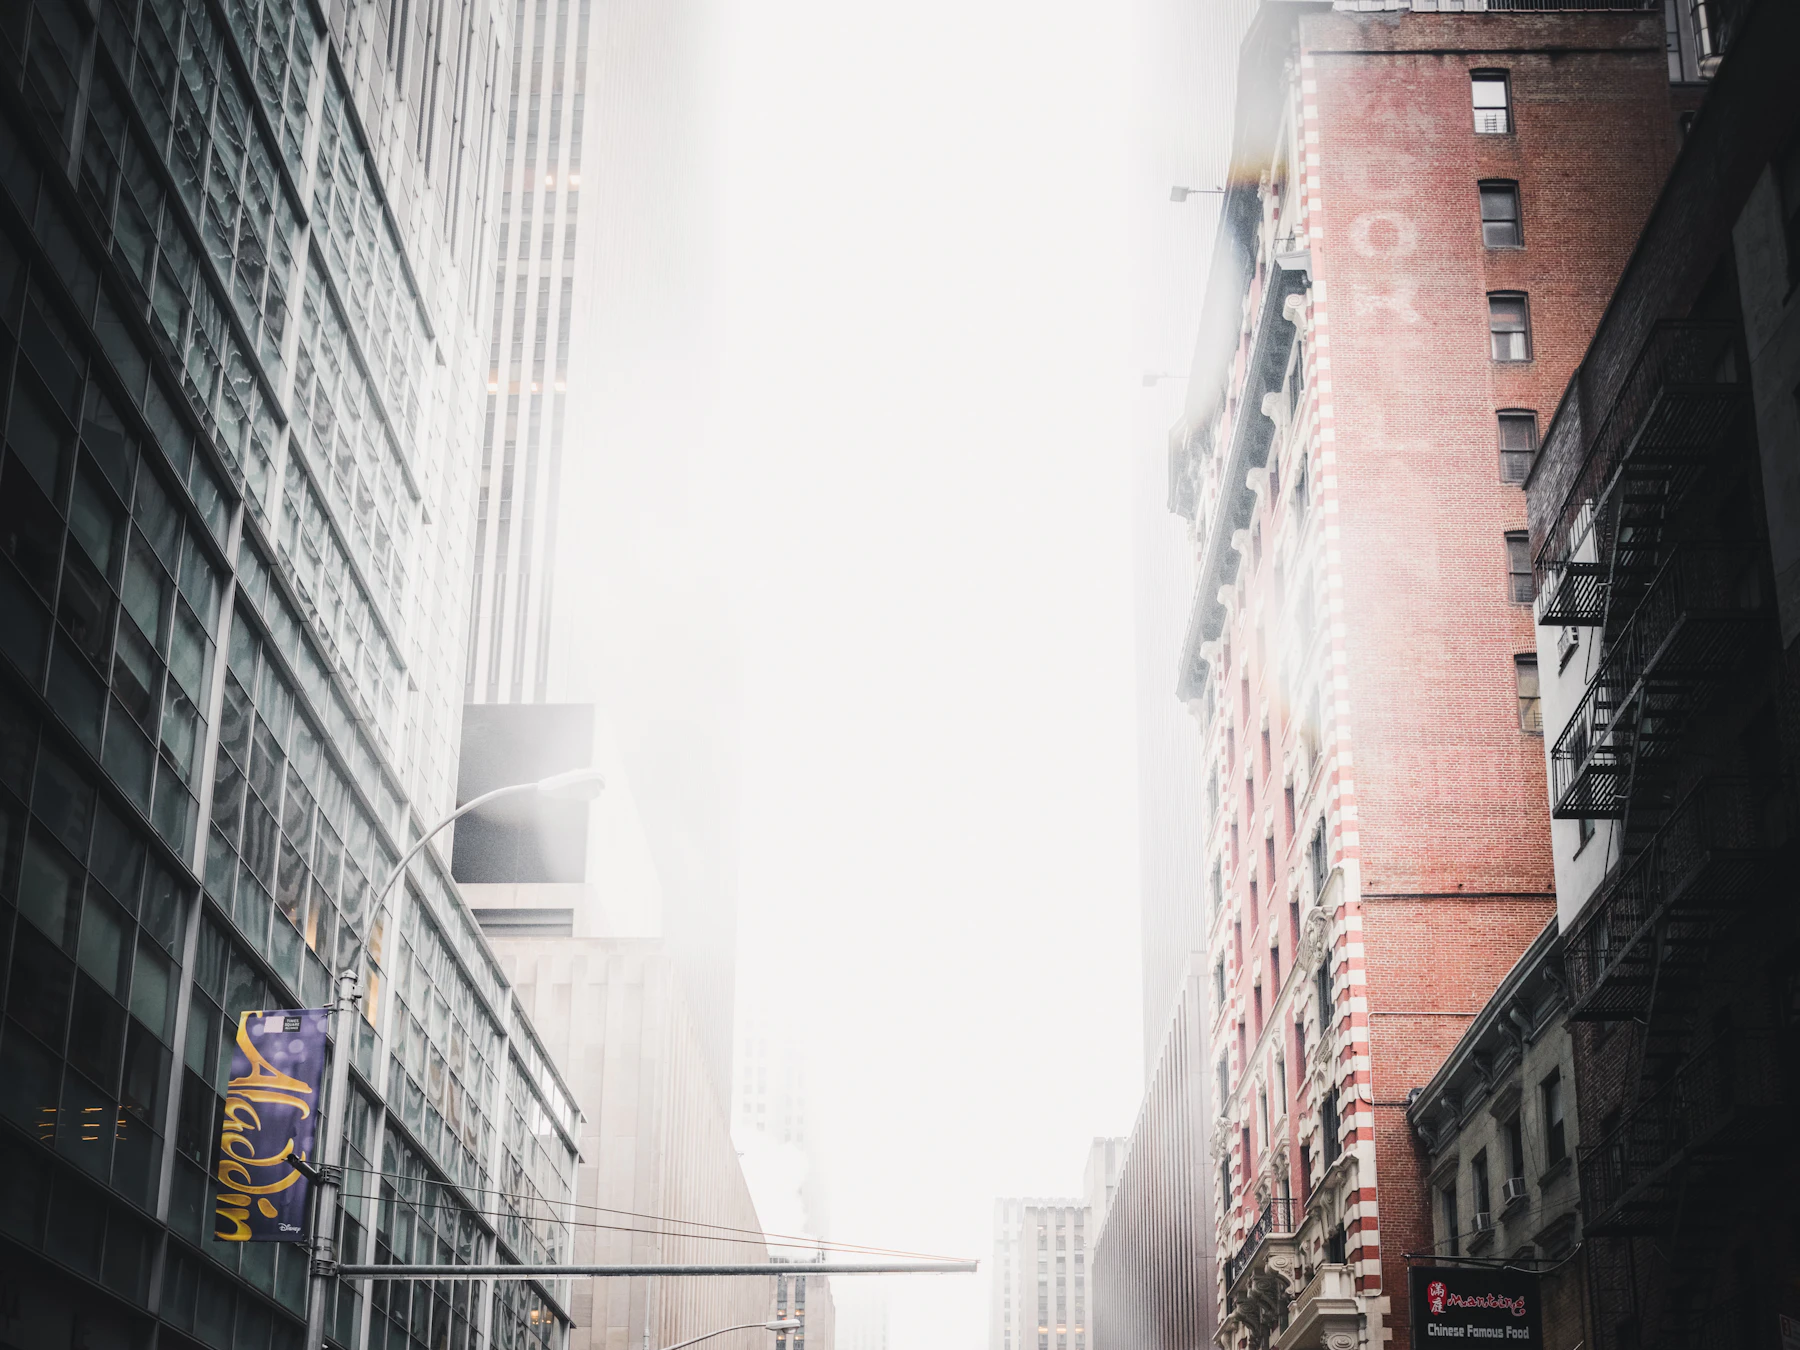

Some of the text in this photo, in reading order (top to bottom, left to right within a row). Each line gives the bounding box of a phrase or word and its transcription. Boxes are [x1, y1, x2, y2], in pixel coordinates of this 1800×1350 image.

[278, 1223, 301, 1233] Disney
[1447, 1291, 1526, 1317] Manting
[1427, 1323, 1530, 1340] Chinese Famous Food
